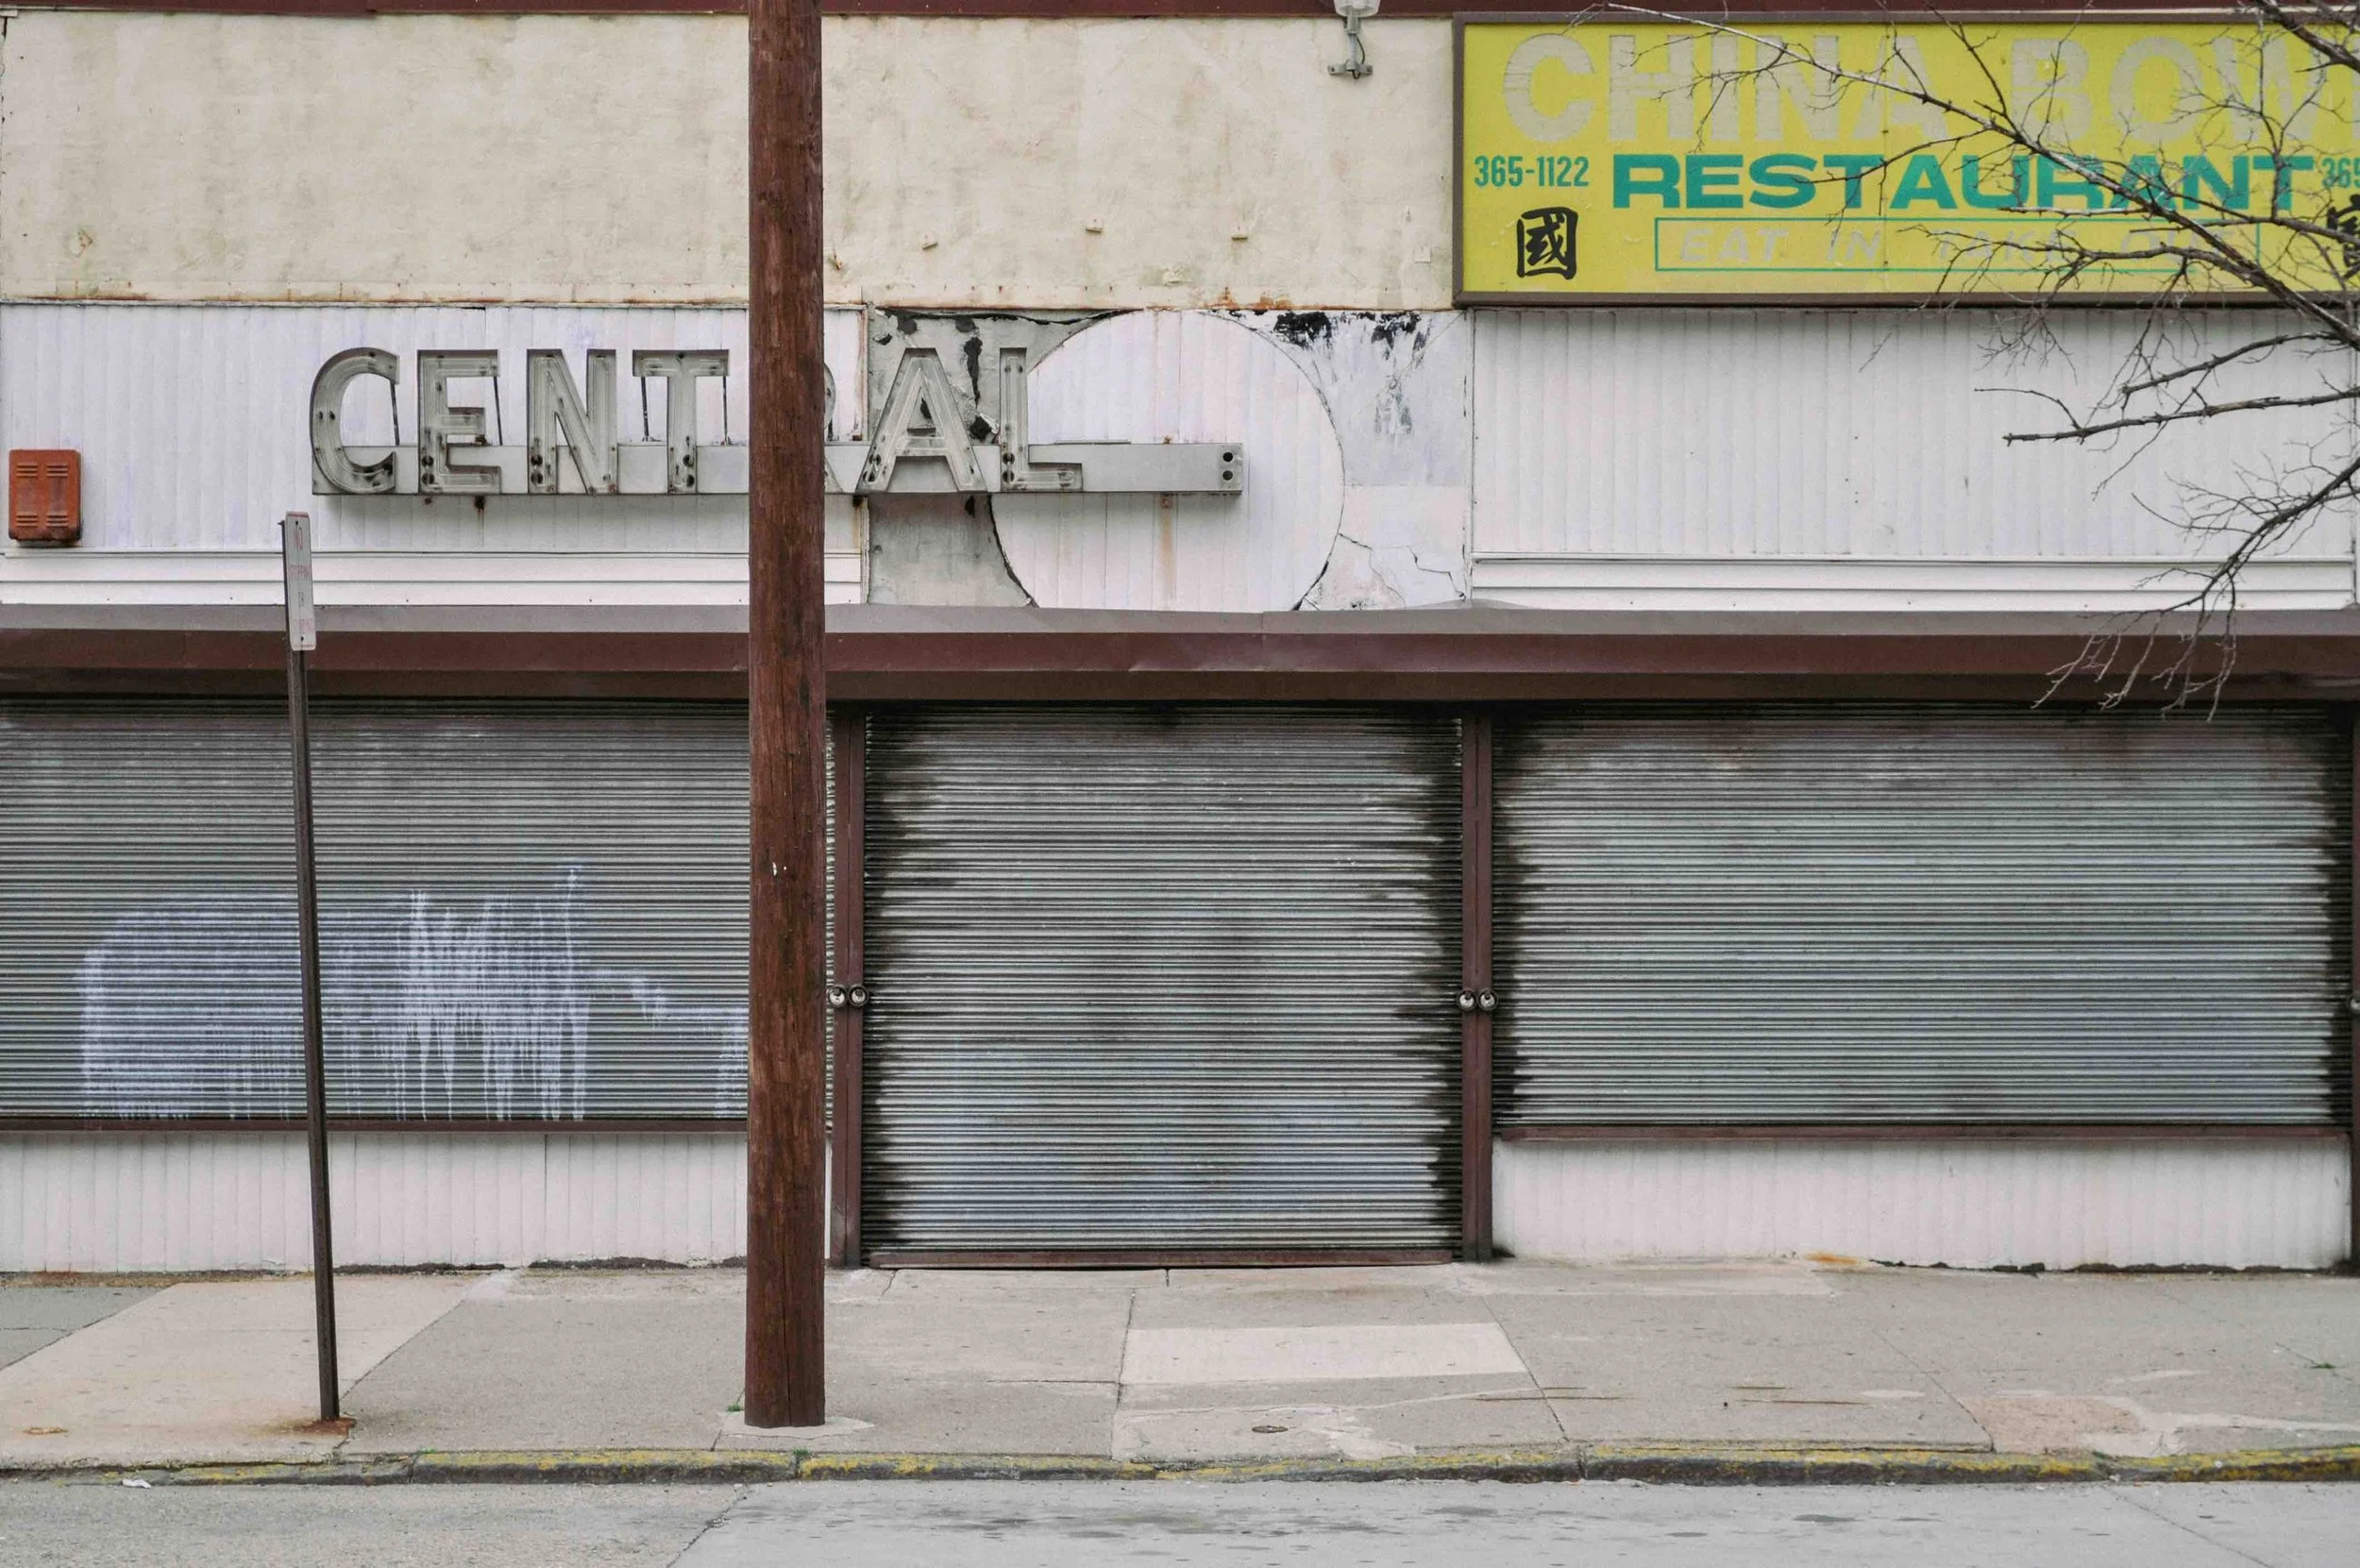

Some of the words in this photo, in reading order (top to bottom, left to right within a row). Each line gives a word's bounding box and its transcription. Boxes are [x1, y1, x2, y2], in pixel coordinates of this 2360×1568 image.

[1504, 33, 1947, 143] CHINA
[2011, 37, 2360, 144] BOW
[1474, 155, 1589, 187] 365-1122
[1612, 154, 2315, 211] RESTAURANT
[1680, 227, 1789, 262] EAT
[1827, 228, 1881, 261] IN
[309, 346, 1084, 495] CENTAL
